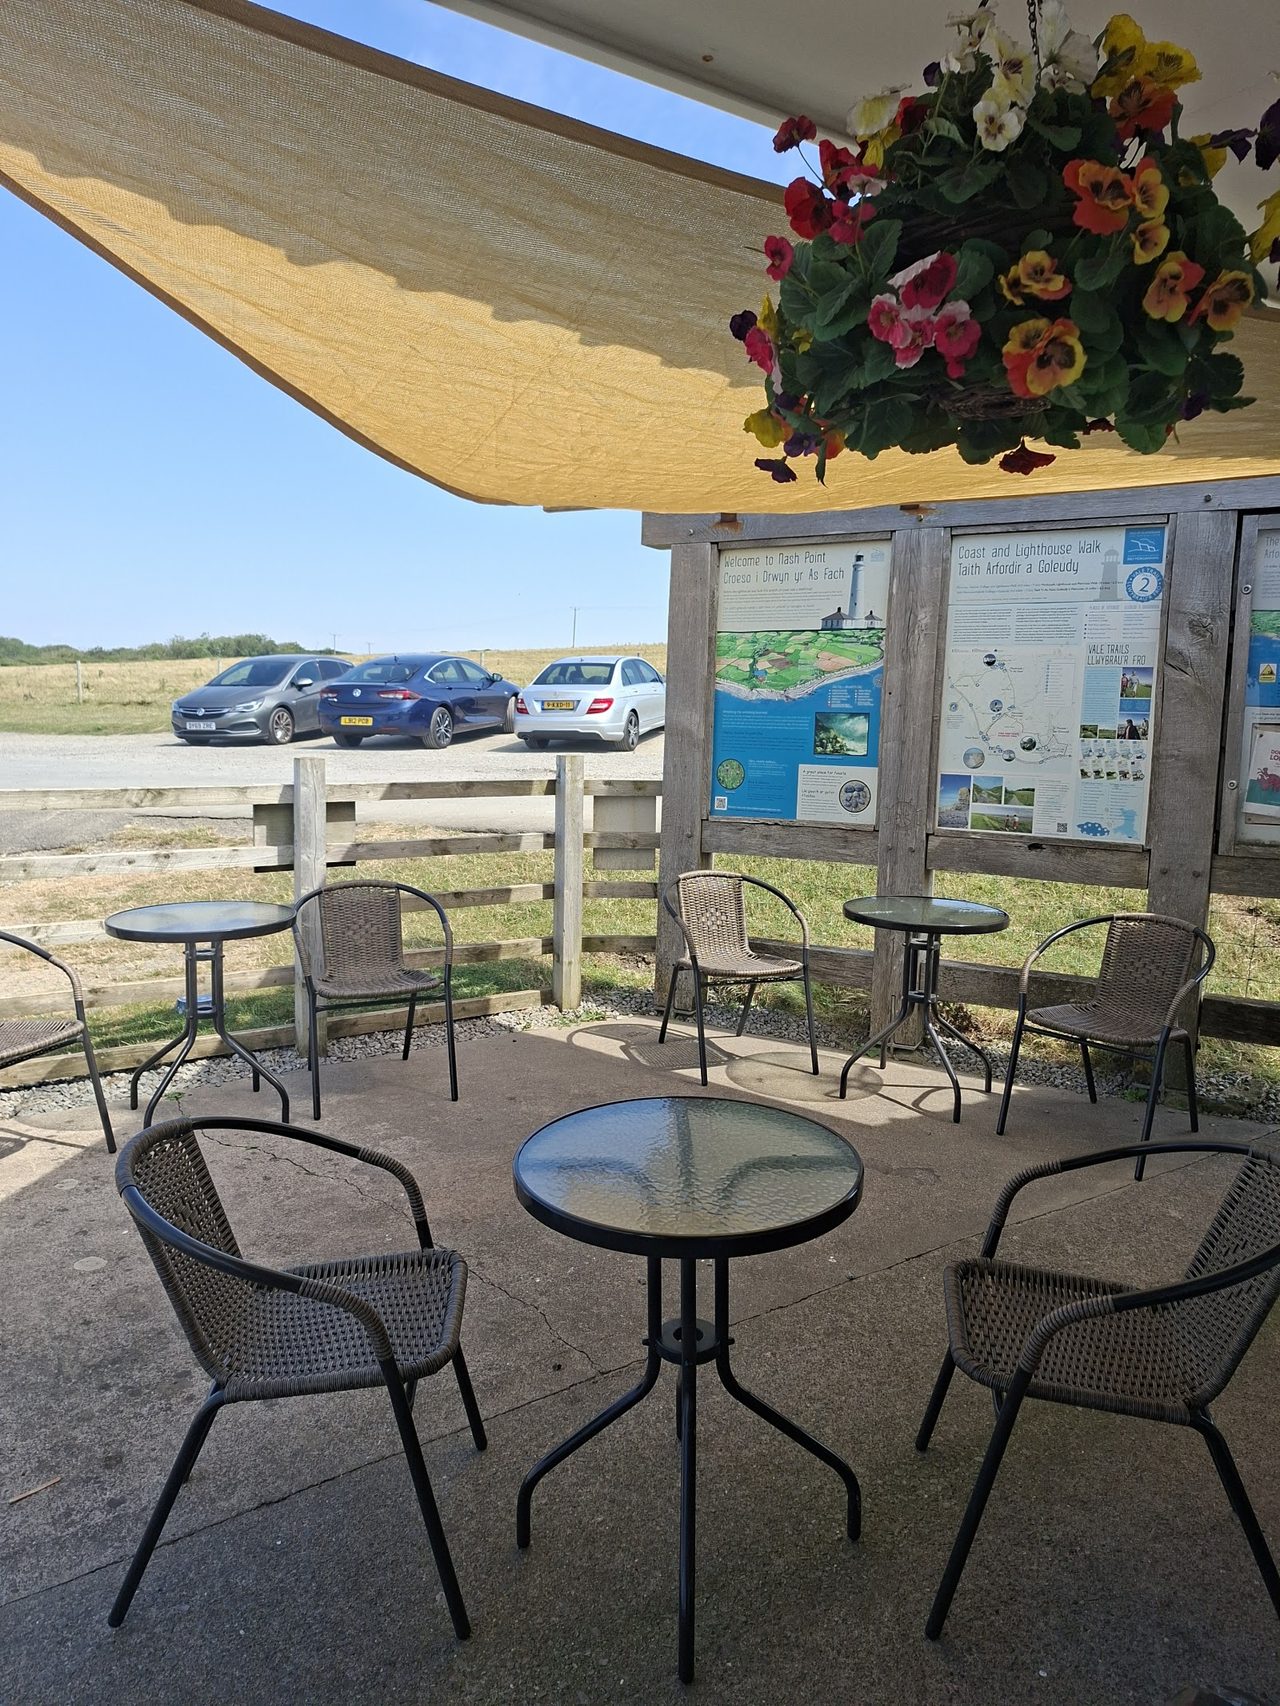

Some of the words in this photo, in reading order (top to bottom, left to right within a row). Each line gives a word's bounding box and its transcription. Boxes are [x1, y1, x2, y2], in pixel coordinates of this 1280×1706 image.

[958, 545, 986, 559] Coast
[991, 543, 1010, 558] and
[1015, 542, 1073, 559] Lighthouse
[1078, 539, 1102, 554] Walk
[724, 556, 760, 568] Welcome
[765, 555, 774, 566] to
[778, 552, 800, 565] Nash
[804, 551, 826, 564] Point
[958, 561, 981, 576] Taith
[986, 559, 1022, 575] Arfordir
[1026, 563, 1033, 574] a
[1038, 558, 1080, 575] Goleudy
[723, 572, 752, 584] Croeso
[762, 570, 790, 584] Drwyn
[794, 571, 803, 583] yr
[808, 568, 819, 580] As
[823, 567, 845, 580] Fach
[1139, 577, 1150, 592] 2
[1088, 644, 1105, 655] VALE
[1107, 644, 1130, 655] TRAILS
[1132, 654, 1146, 666] FRO
